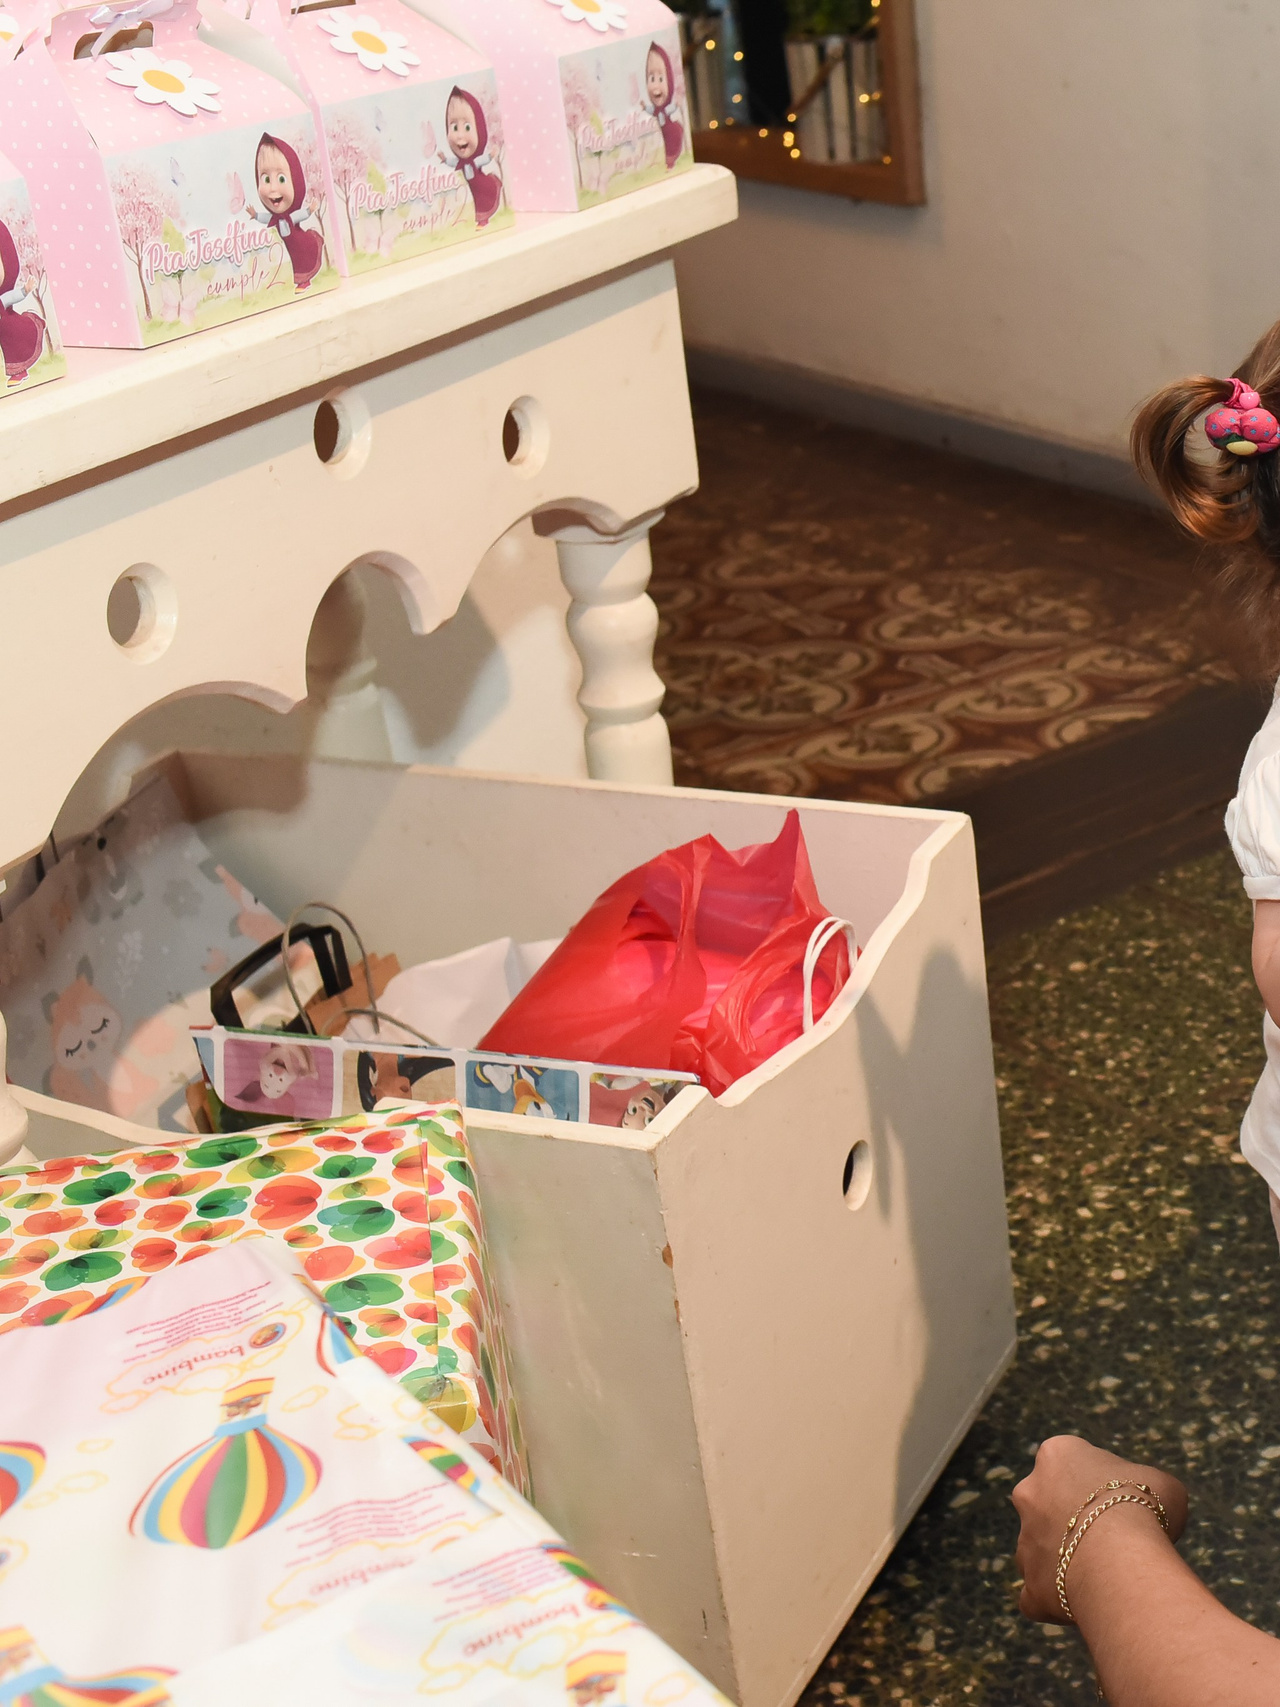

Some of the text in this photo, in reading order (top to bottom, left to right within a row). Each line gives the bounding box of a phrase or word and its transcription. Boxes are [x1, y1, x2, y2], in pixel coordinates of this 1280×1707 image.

[207, 242, 286, 301] cumple 2
[142, 1345, 245, 1385] bambino
